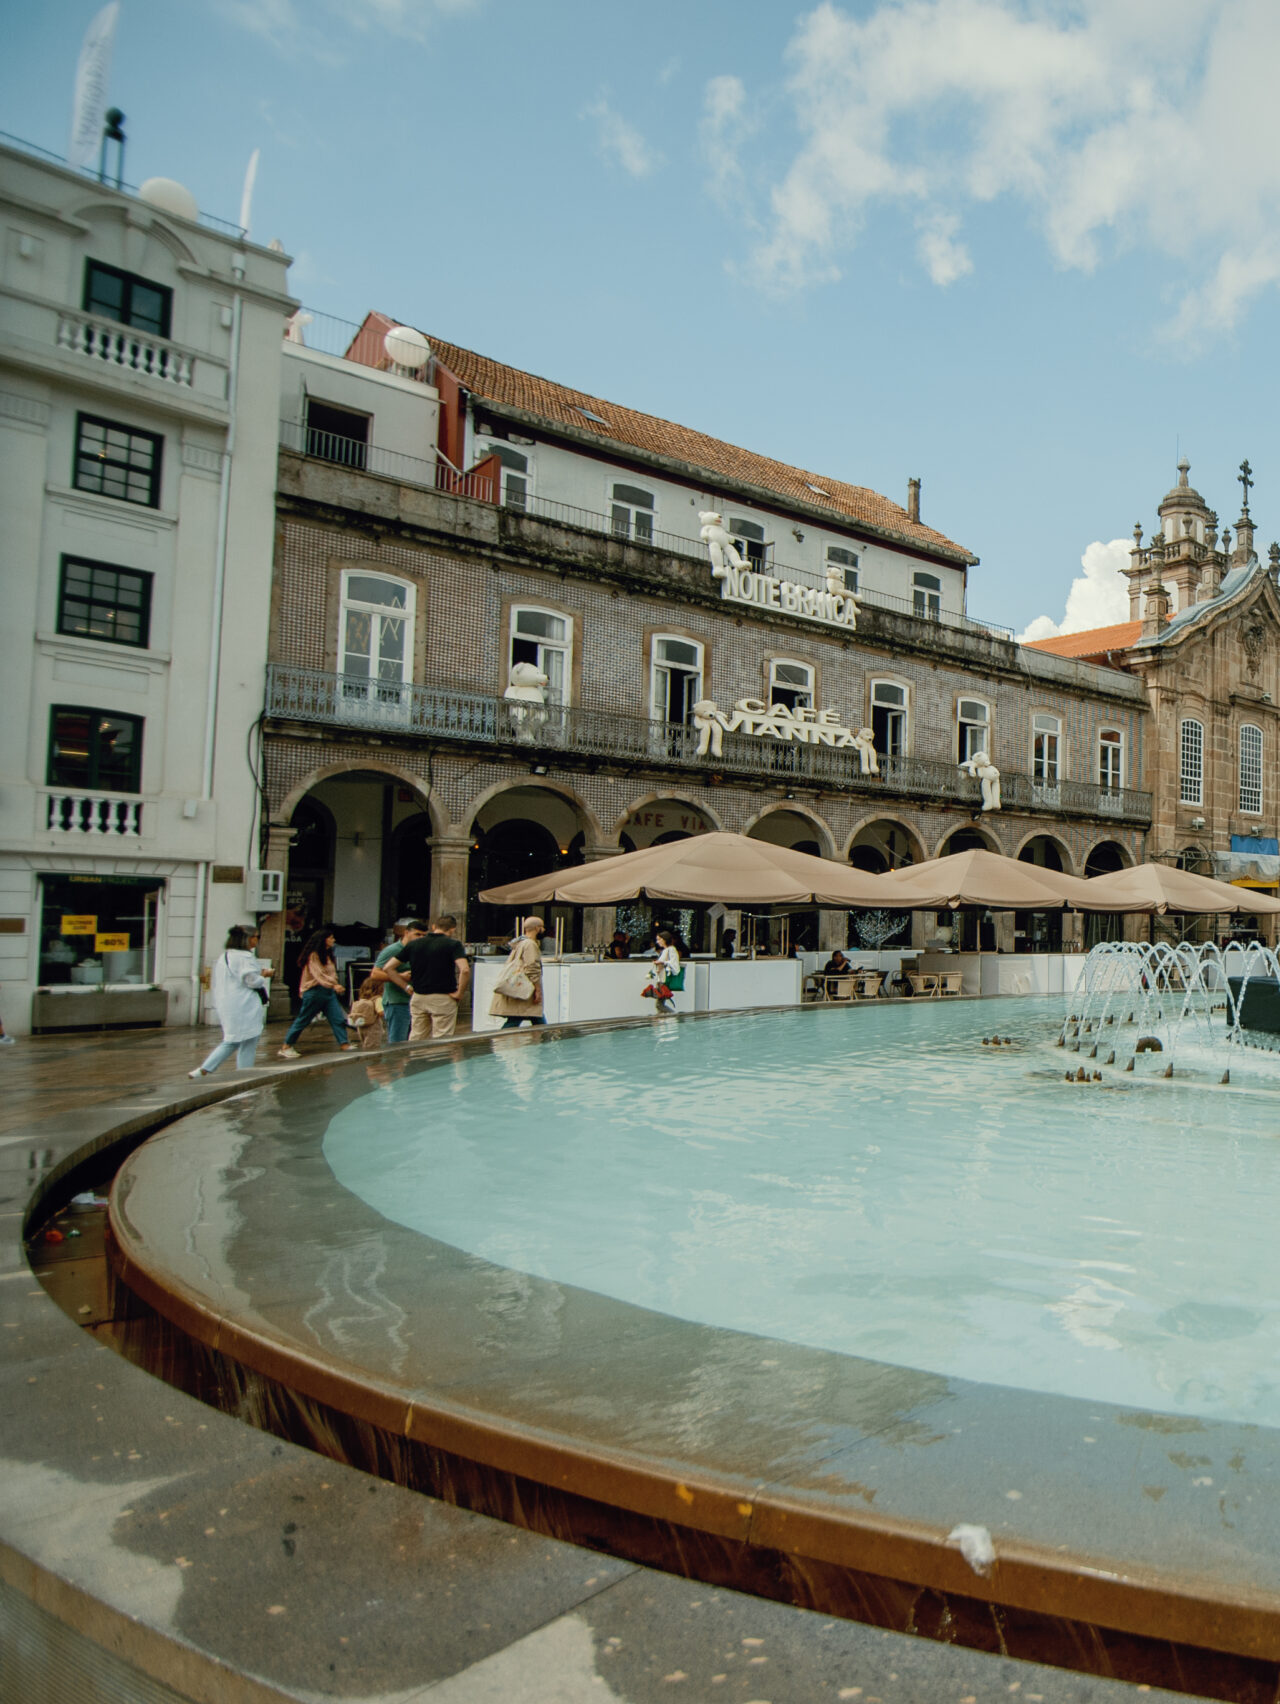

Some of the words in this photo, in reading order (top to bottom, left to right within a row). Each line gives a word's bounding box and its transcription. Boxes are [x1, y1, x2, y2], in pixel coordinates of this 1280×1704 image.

[722, 565, 781, 608] NOITE
[780, 581, 857, 627] BRANCA
[717, 710, 861, 750] VIANNA
[735, 698, 841, 728] CAFÉ
